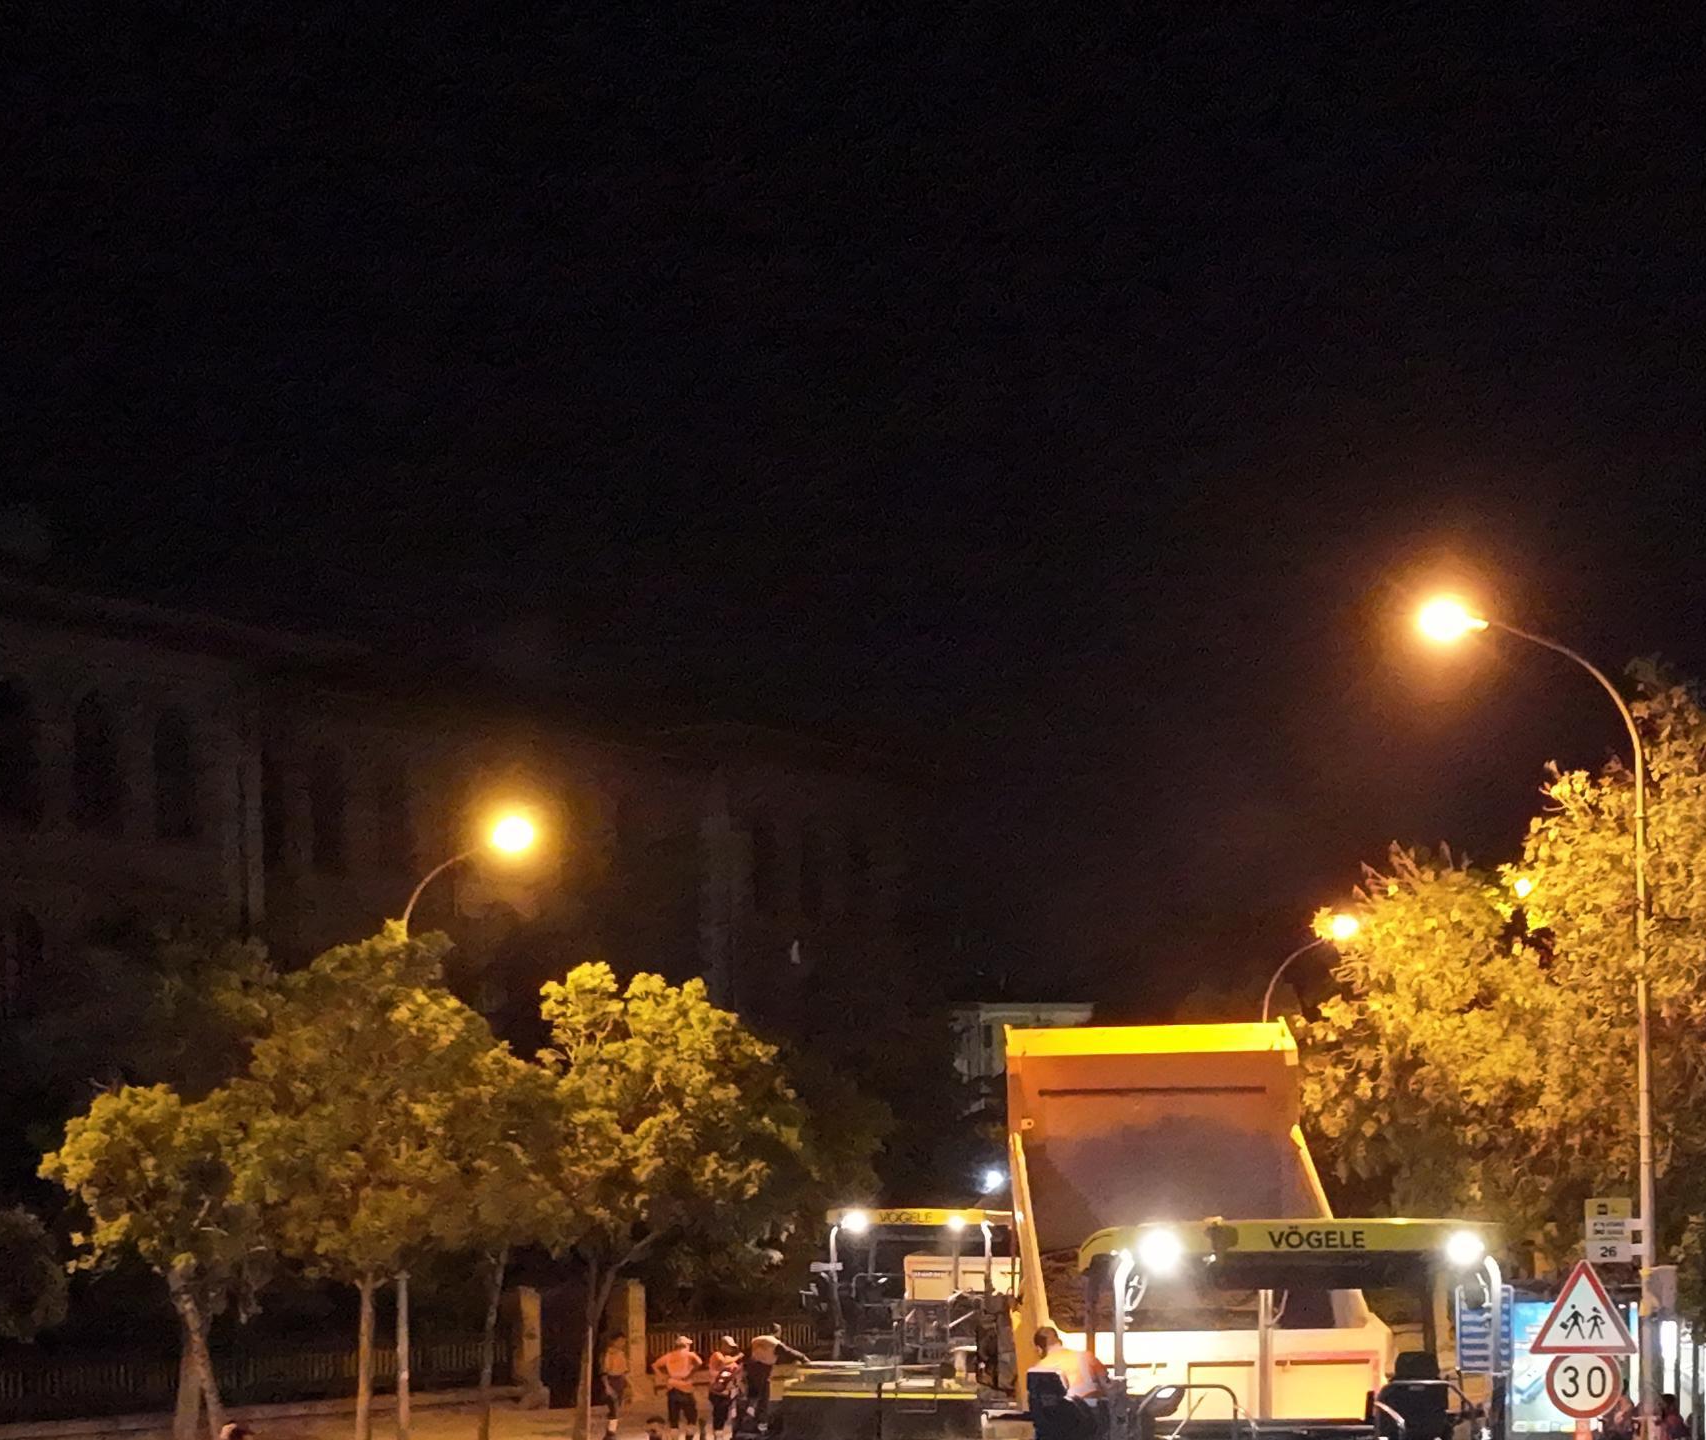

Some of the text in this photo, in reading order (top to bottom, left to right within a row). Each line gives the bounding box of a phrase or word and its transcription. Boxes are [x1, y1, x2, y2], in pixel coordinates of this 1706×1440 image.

[1268, 1225, 1365, 1249] VÖGELE
[1599, 1245, 1618, 1258] 26
[1560, 1365, 1607, 1399] 30
